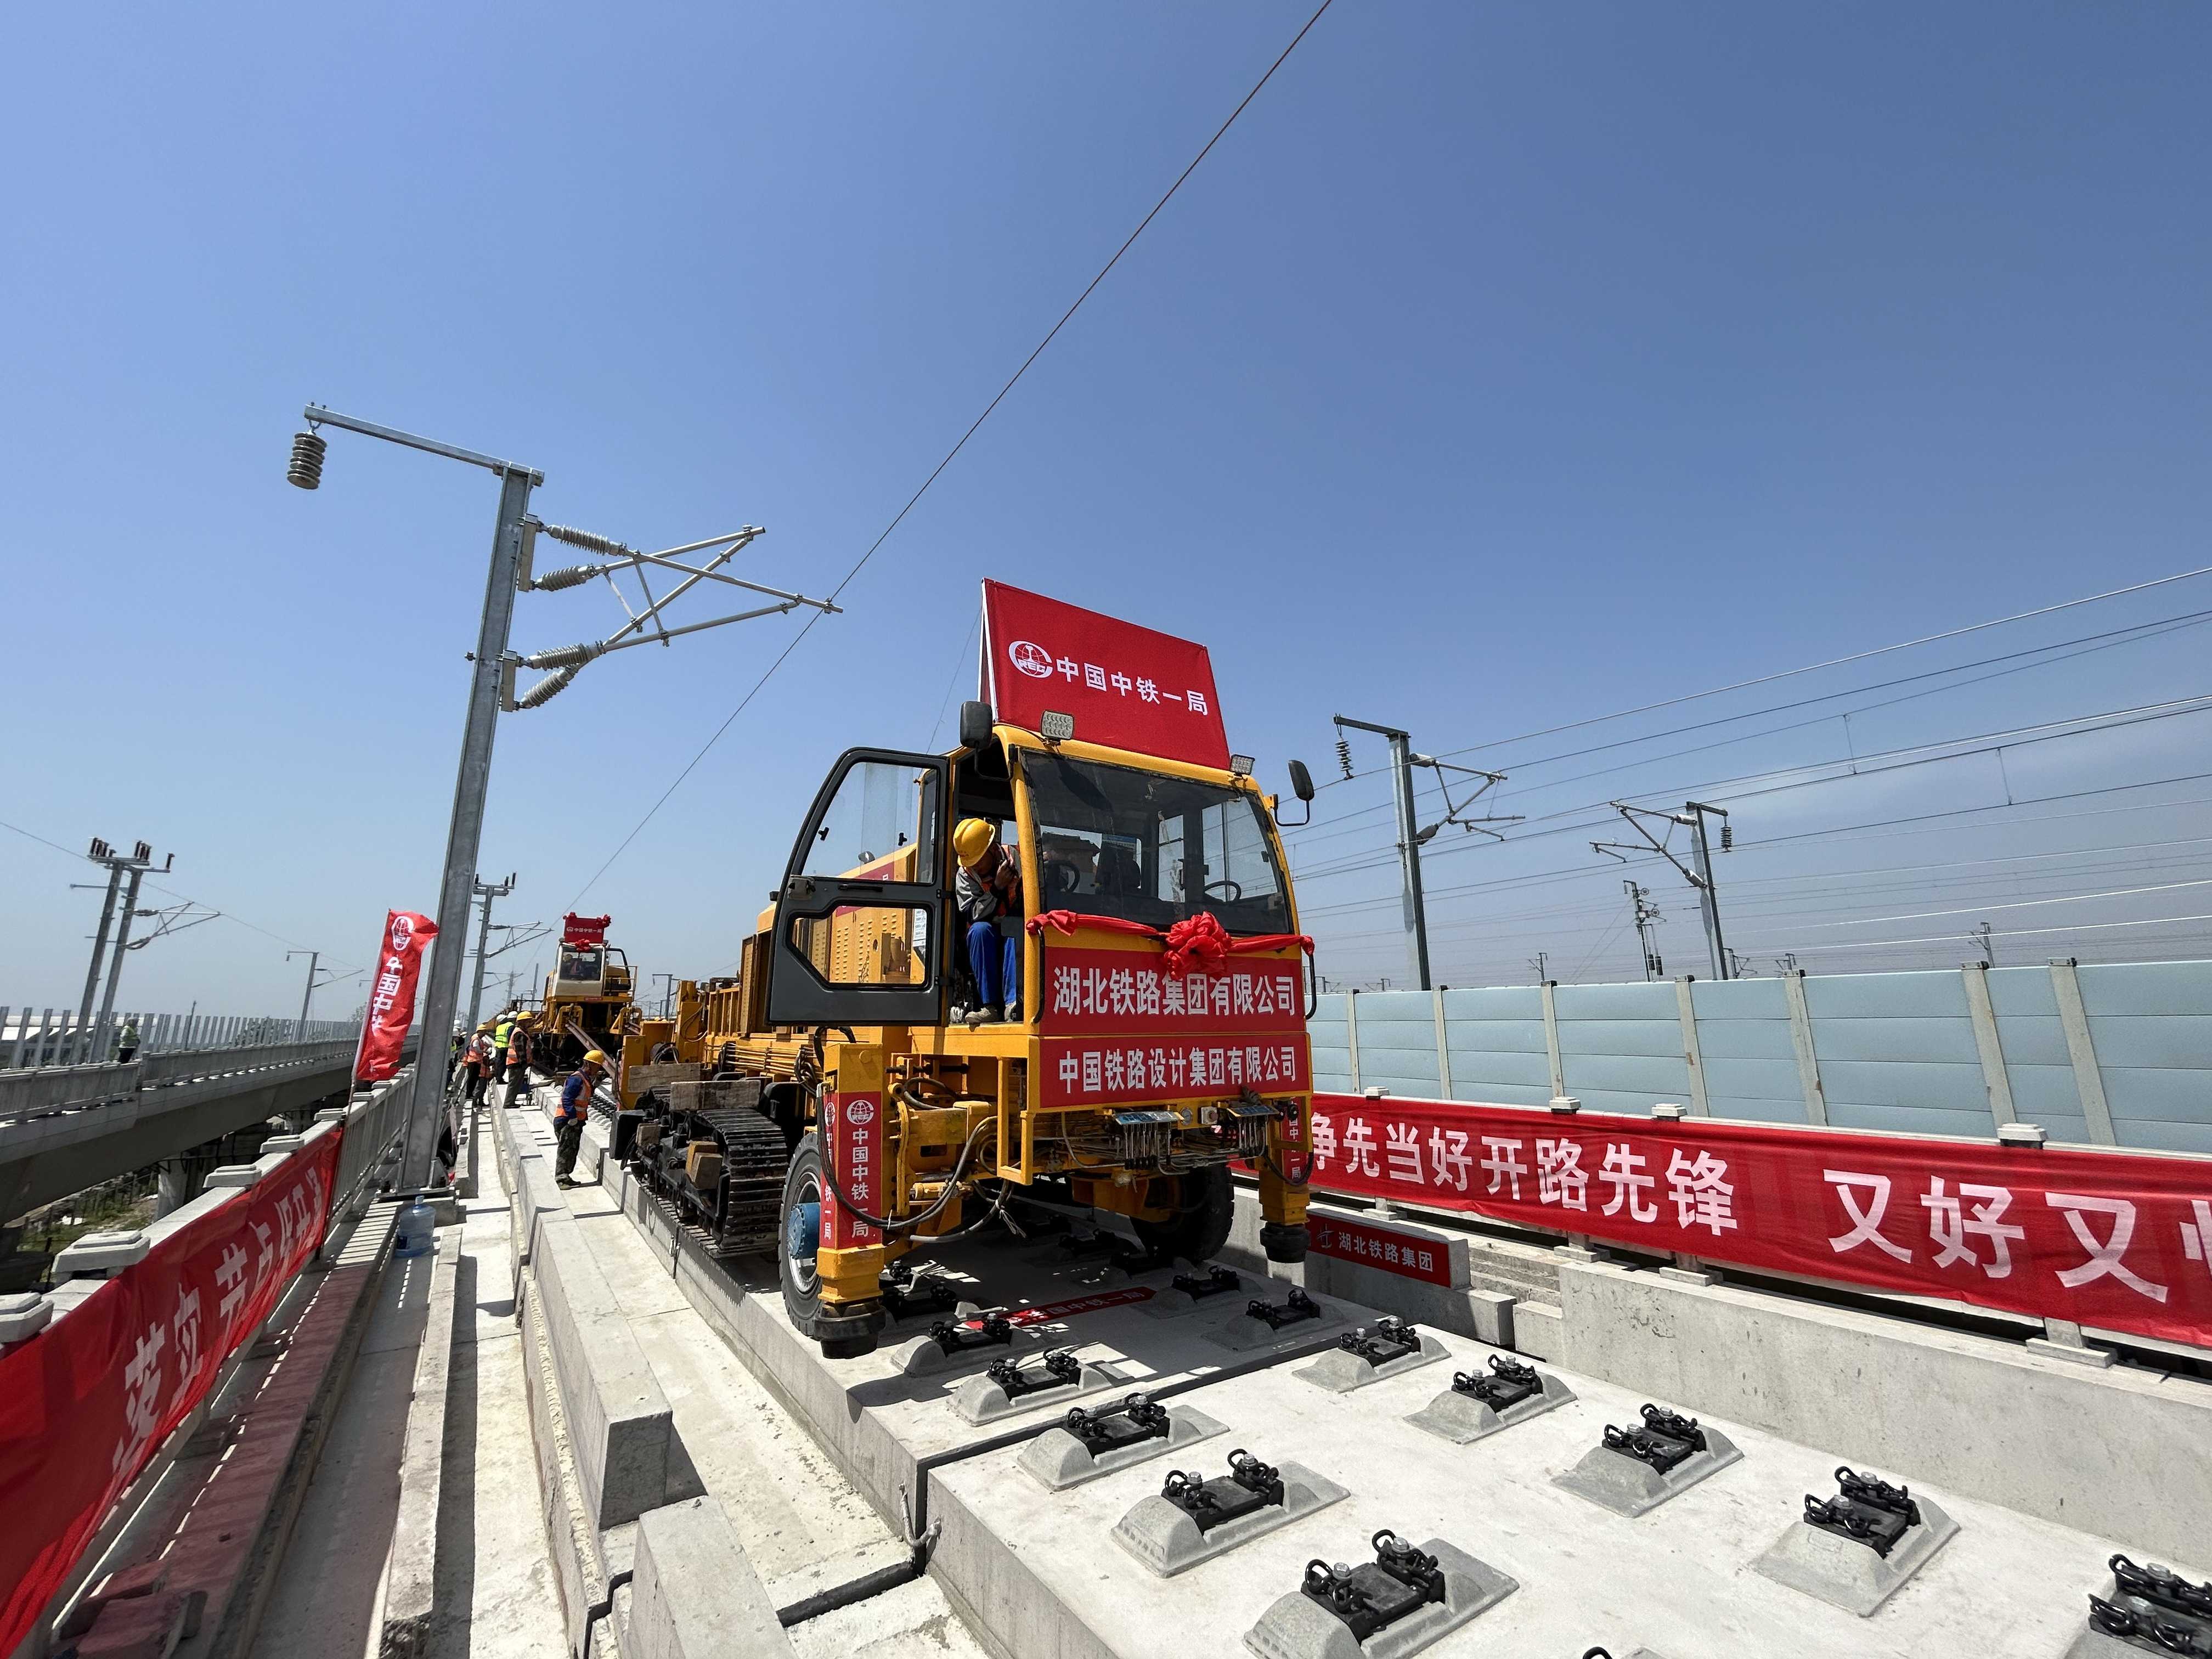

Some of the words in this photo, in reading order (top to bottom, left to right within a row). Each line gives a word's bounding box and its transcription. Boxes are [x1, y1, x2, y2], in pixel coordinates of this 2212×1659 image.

[1055, 656, 1208, 715] 中国中铁一局
[1053, 966, 1295, 1016] 湖北铁路集团有限公司
[1059, 1046, 1296, 1094] 中国铁路设计集团有限公司
[824, 1132, 833, 1240] 中铁一局
[851, 1127, 869, 1238] 中国中铁一局
[1311, 1111, 1738, 1236] 争先当好开路先锋
[1339, 1232, 1434, 1272] 湖北铁路集团
